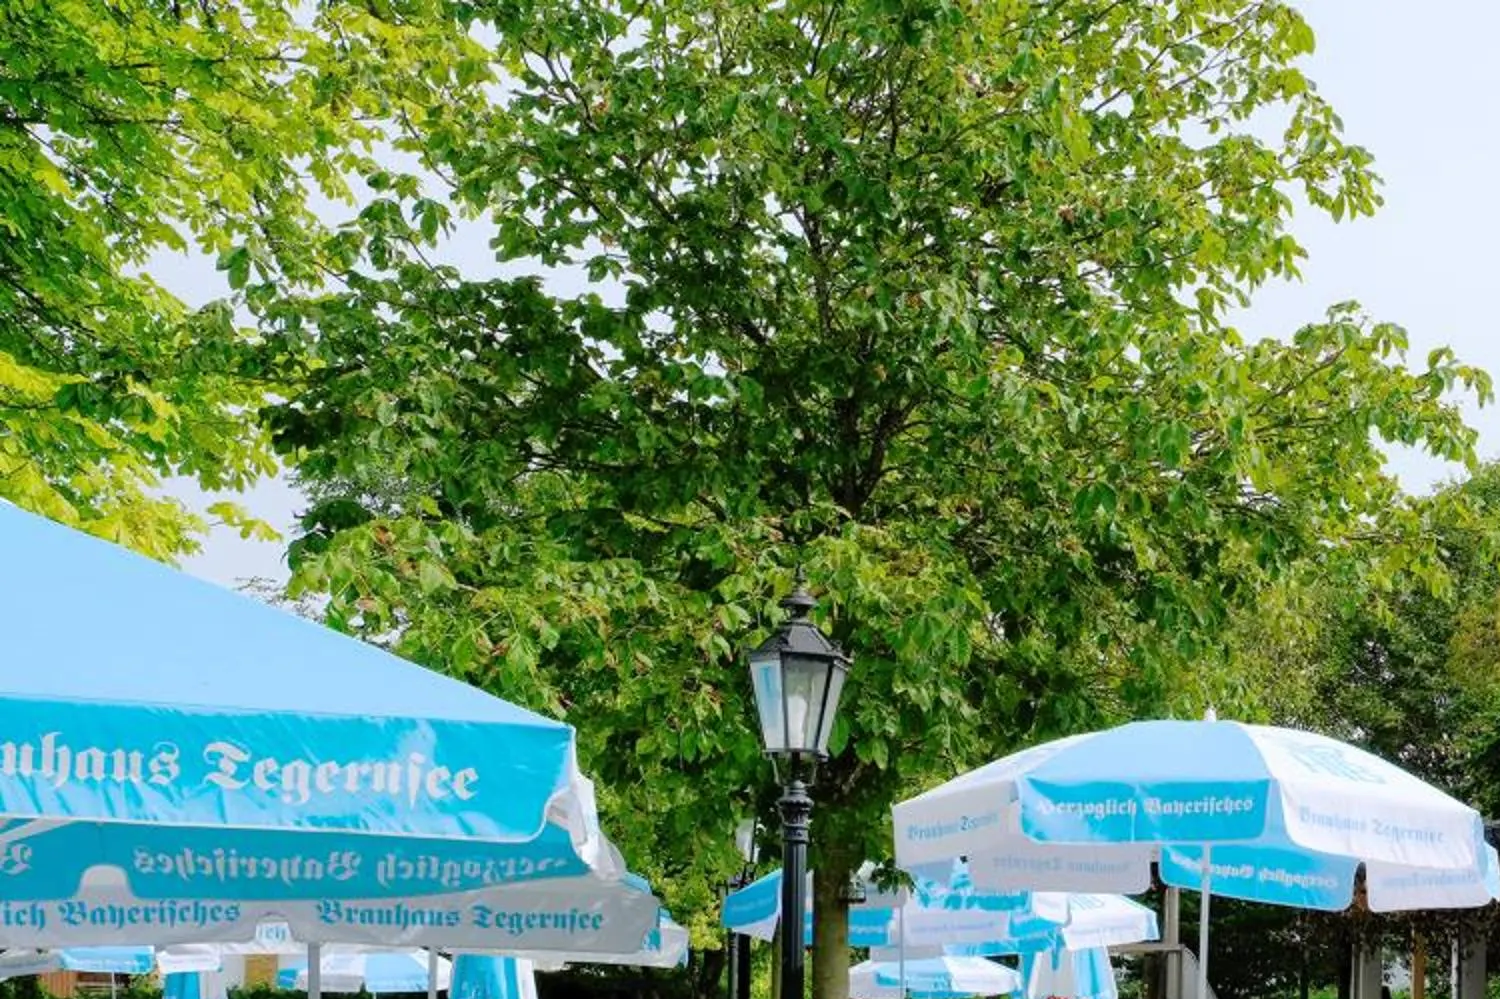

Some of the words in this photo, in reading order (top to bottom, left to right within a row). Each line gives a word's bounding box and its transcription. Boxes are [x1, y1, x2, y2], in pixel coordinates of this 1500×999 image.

[202, 740, 480, 808] Tegernsee
[57, 900, 242, 930] Bayerisches
[315, 899, 461, 930] Brauhaus
[471, 904, 605, 936] Tegernsee
